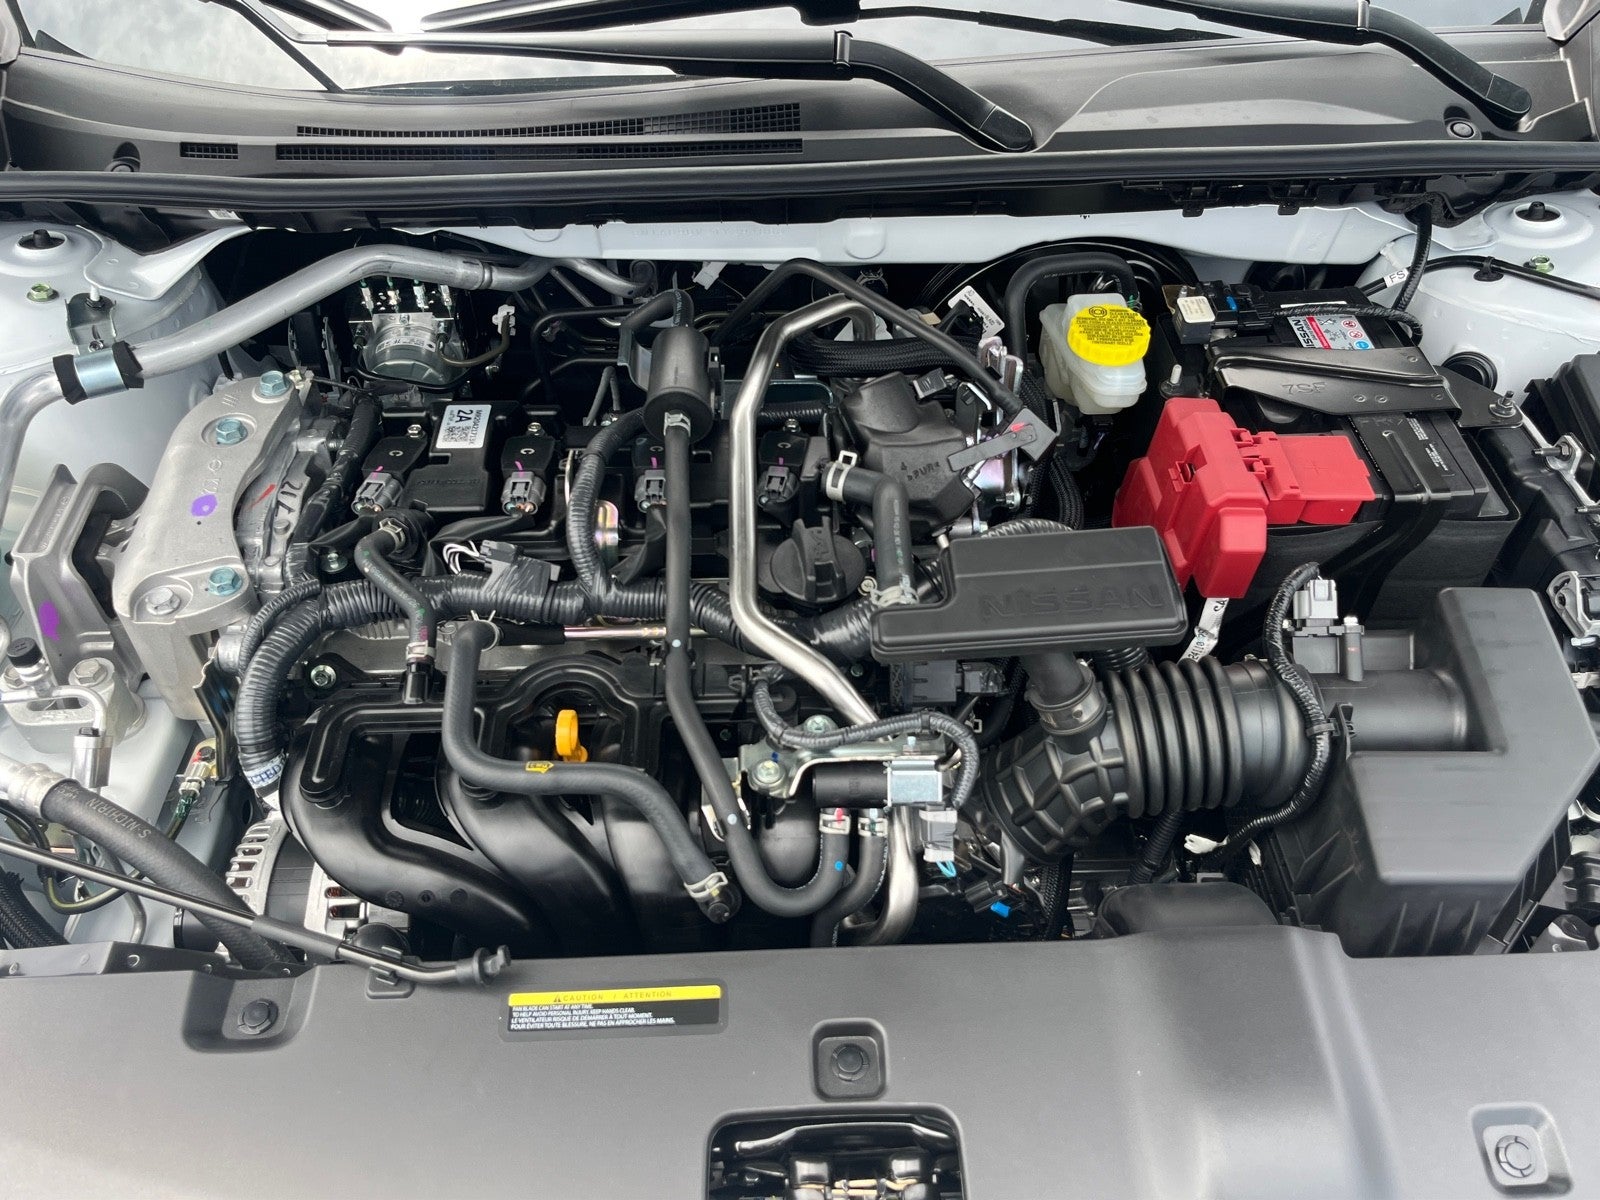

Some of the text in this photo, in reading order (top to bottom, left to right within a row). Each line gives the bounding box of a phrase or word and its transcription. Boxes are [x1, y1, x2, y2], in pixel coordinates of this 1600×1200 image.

[1389, 270, 1406, 283] FS
[1292, 319, 1316, 348] ISSAN
[455, 410, 474, 423] 2A
[624, 991, 672, 1000] ATTENTION
